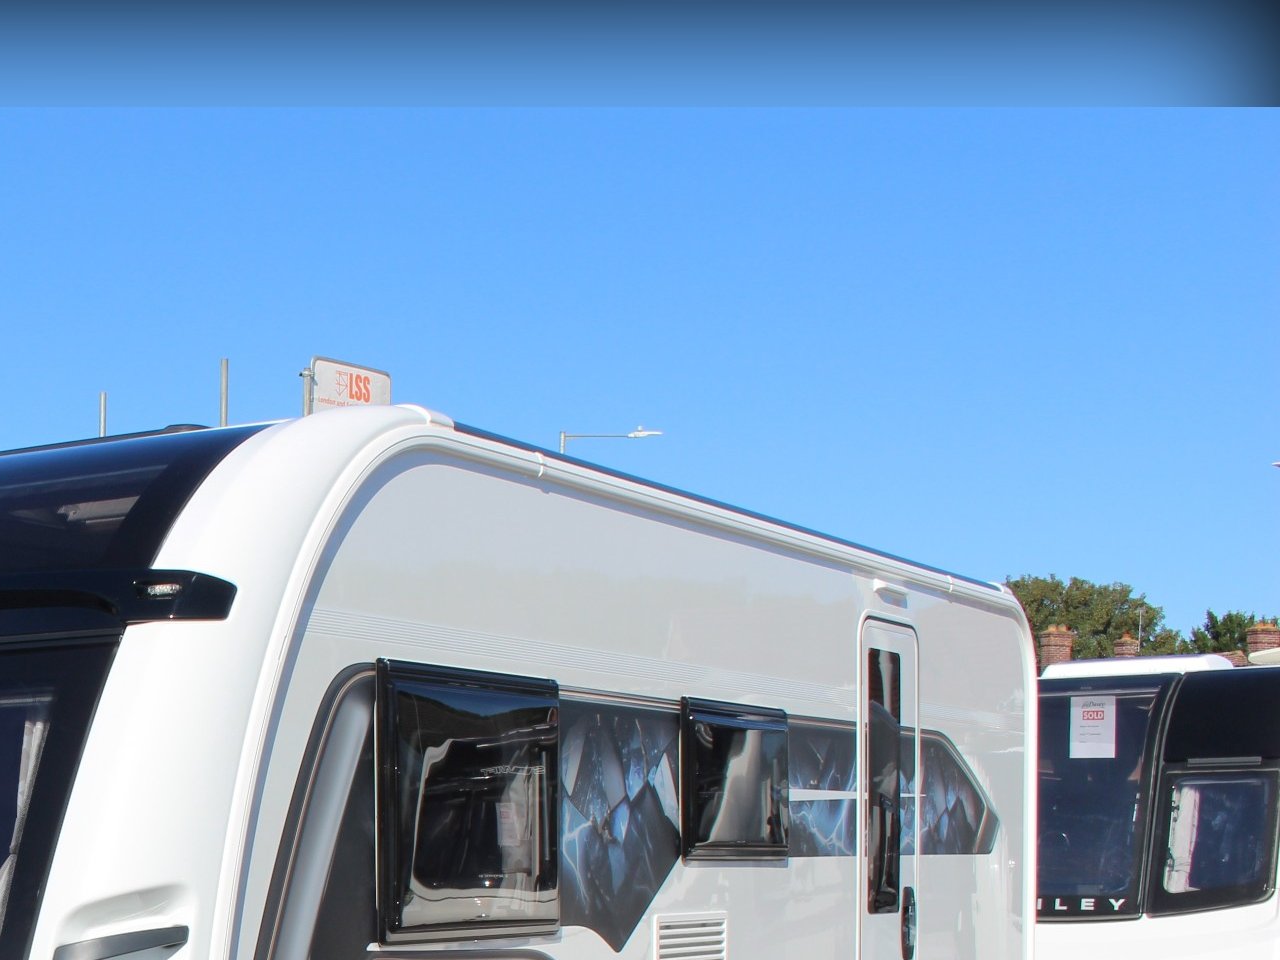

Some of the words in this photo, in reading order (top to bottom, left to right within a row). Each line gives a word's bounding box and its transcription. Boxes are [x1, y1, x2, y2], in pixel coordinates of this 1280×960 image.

[348, 372, 371, 403] LSS
[1082, 711, 1104, 720] SOLD
[1037, 898, 1126, 911] ILEY
